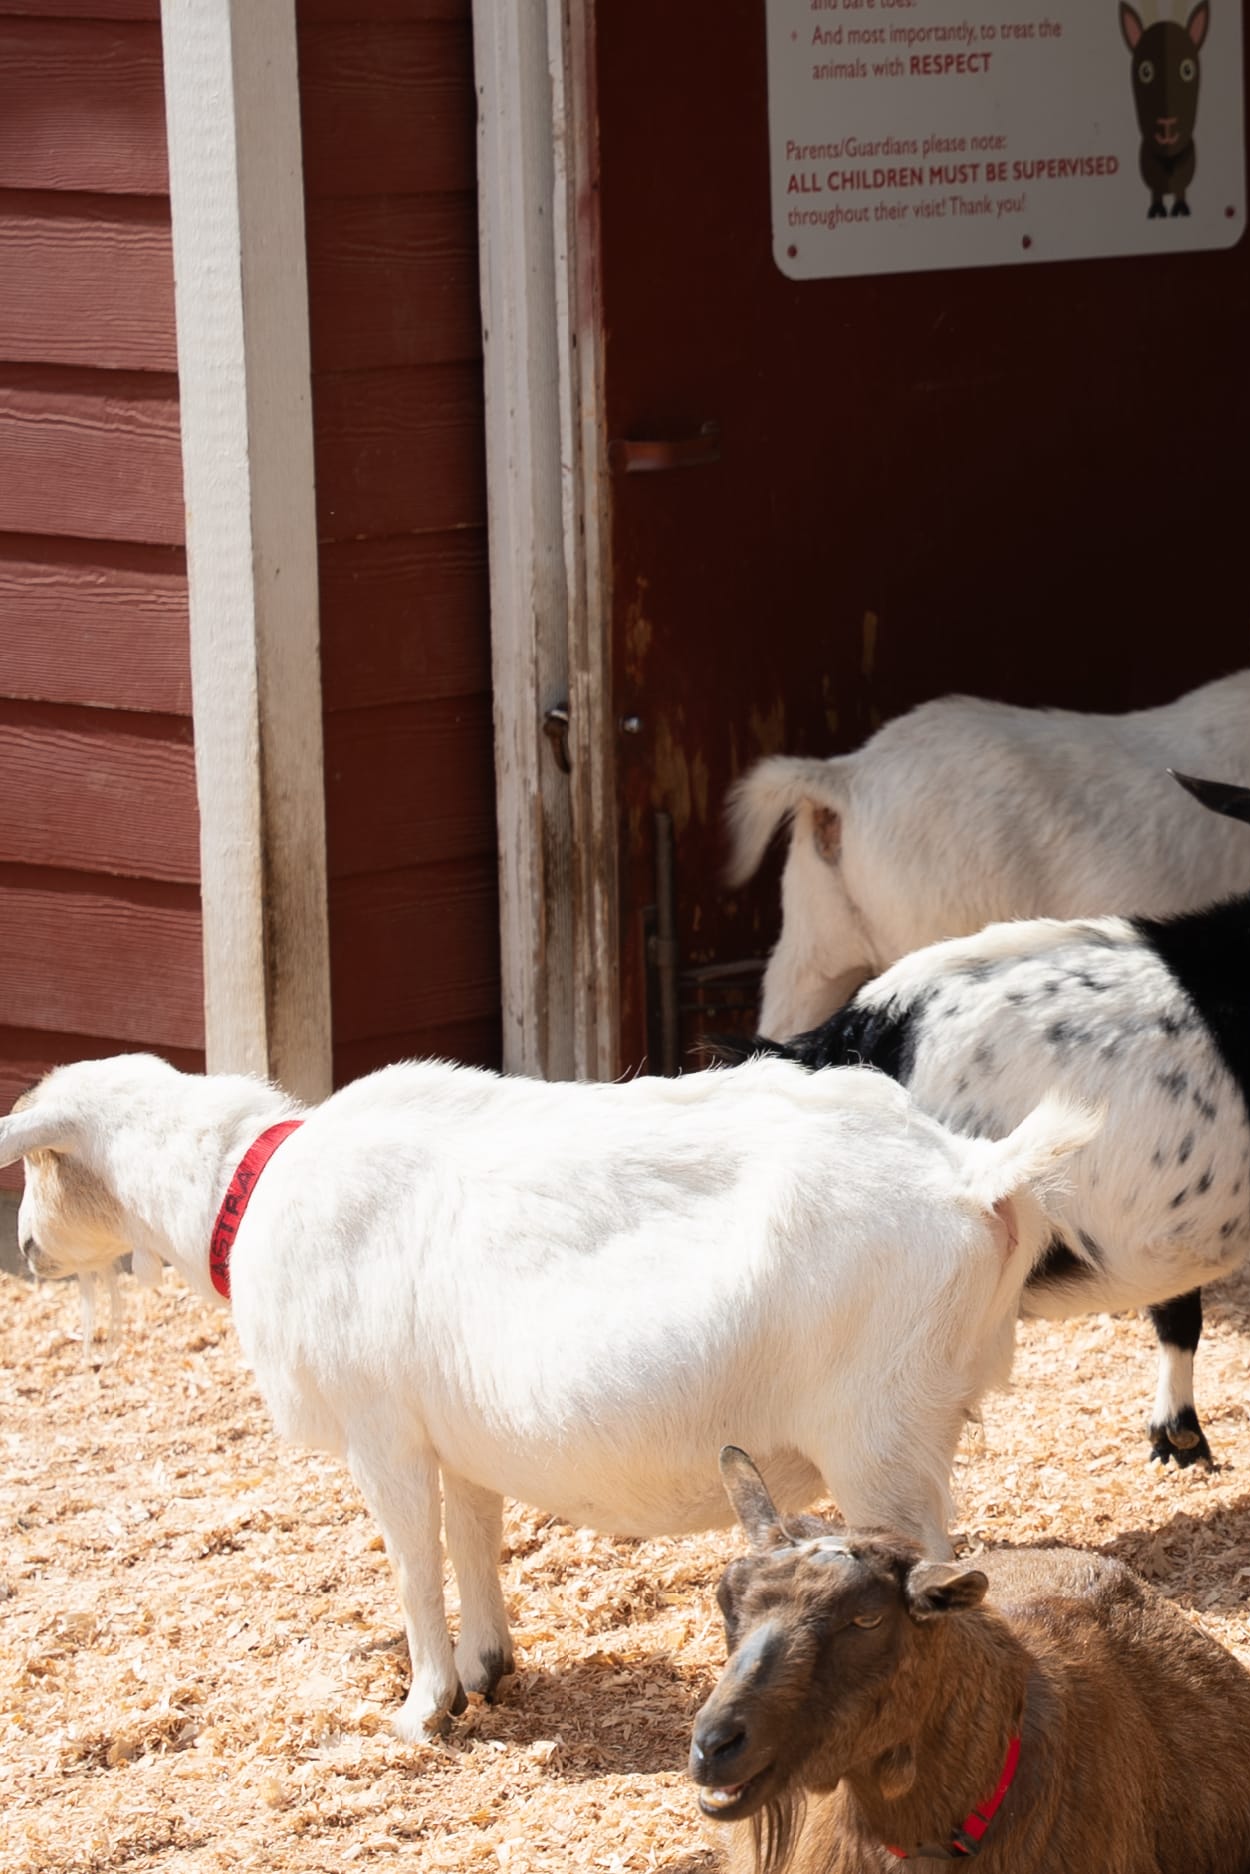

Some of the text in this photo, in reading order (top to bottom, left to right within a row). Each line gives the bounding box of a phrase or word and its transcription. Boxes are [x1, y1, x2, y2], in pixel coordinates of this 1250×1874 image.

[812, 20, 1062, 48] And most importantly, to treat the
[812, 53, 992, 80] animals with RESPECT
[786, 134, 1007, 160] Parents/Guardians please note:
[787, 156, 1119, 195] ALL CHILDREN MUST BE SUPERVISED
[788, 193, 1025, 230] throughout their visit! Thank you!
[210, 1168, 255, 1278] ASTRA
